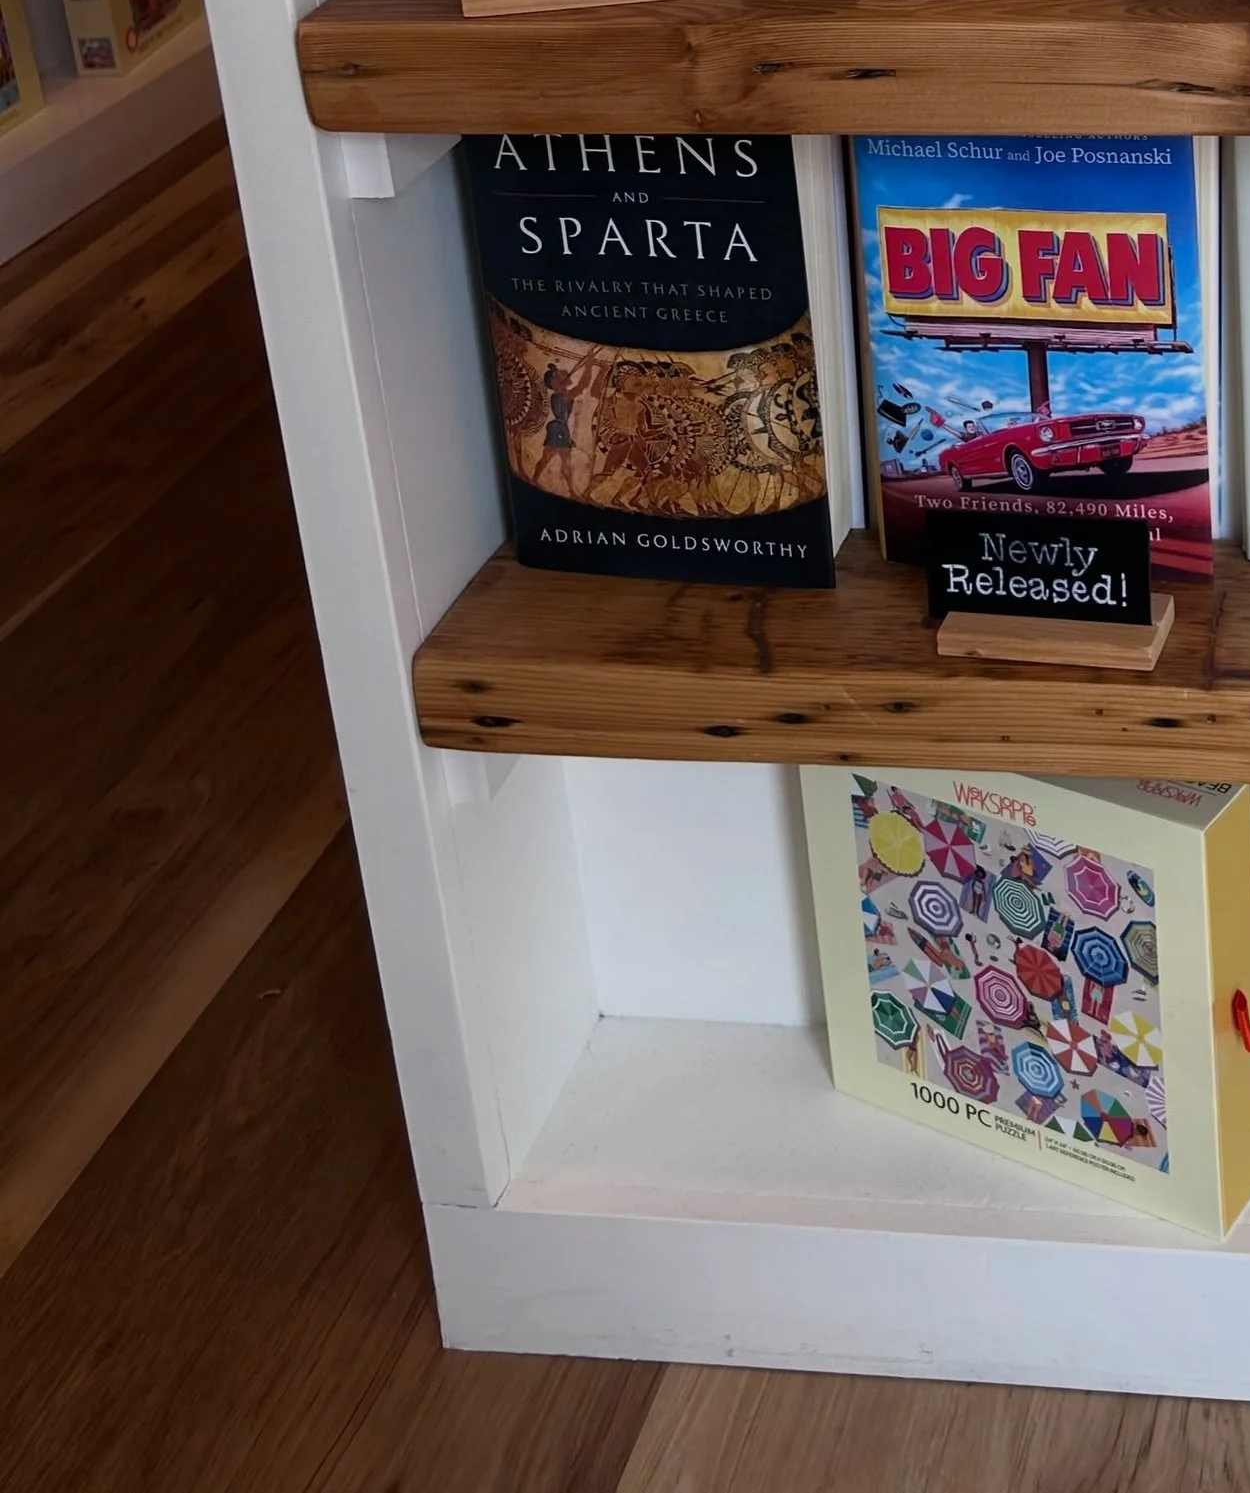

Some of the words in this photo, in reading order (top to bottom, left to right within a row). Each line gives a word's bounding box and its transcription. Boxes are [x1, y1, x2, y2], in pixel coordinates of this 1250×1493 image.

[494, 134, 758, 178] ATHENS
[867, 138, 943, 158] Michael
[948, 141, 1003, 160] Schur
[1007, 148, 1030, 162] and
[1034, 145, 1066, 165] Joe
[1072, 147, 1172, 166] Posnanski
[612, 191, 649, 204] AND
[519, 216, 758, 262] SPARTA
[884, 226, 1006, 301] BIG
[1017, 230, 1165, 306] FAN
[511, 277, 547, 292] THE
[555, 280, 634, 294] RIVALRY
[641, 282, 690, 298] THAT
[697, 284, 773, 301] SHAPED
[562, 305, 648, 319] ANCIENT
[656, 307, 729, 324] GREECE
[915, 494, 953, 509] Two
[960, 496, 1040, 514] Friends,
[1046, 500, 1108, 518] 82,490
[1115, 505, 1175, 523] Miles,
[540, 527, 627, 546] ADRIAN
[637, 533, 808, 559] GOLDSWORTHY
[980, 533, 1098, 576] Newly
[942, 563, 1127, 607] Released!
[910, 1081, 961, 1115] 1000
[966, 1102, 992, 1129] PC
[994, 1114, 1036, 1138] PREMIUM
[994, 1124, 1028, 1142] PUZZLE
